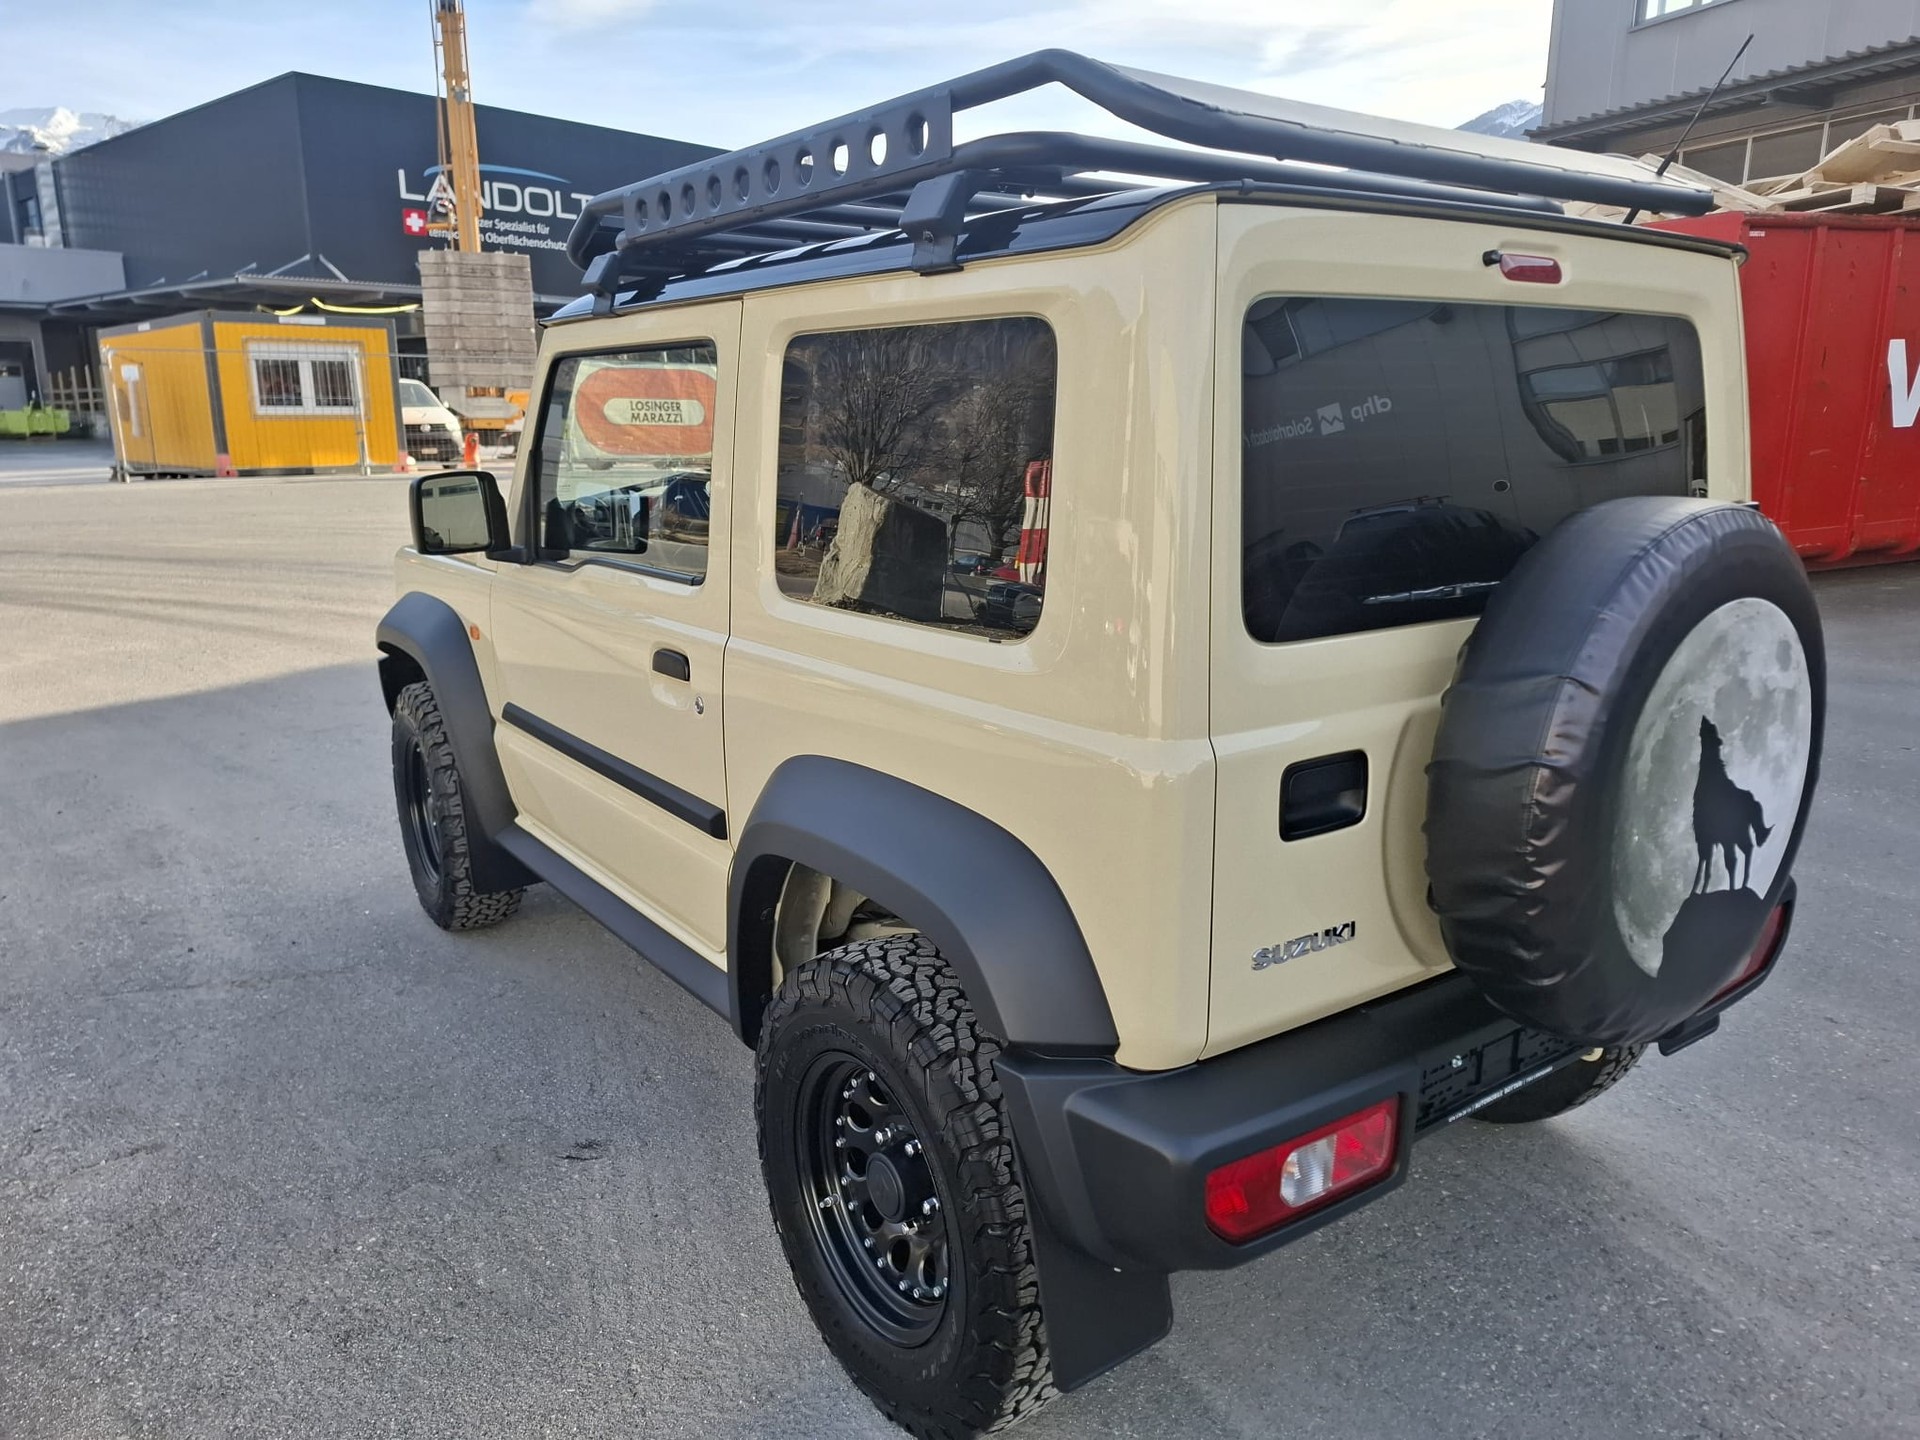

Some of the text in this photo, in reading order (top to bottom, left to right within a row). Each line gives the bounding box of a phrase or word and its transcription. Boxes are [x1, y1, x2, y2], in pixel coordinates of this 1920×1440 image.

[494, 218, 536, 233] Spezialist
[536, 224, 550, 234] für
[485, 232, 567, 250] Oberflächenschutz
[630, 400, 682, 412] LOSINGER
[630, 413, 683, 424] MARAZZI
[1251, 920, 1356, 971] SUZUKI
